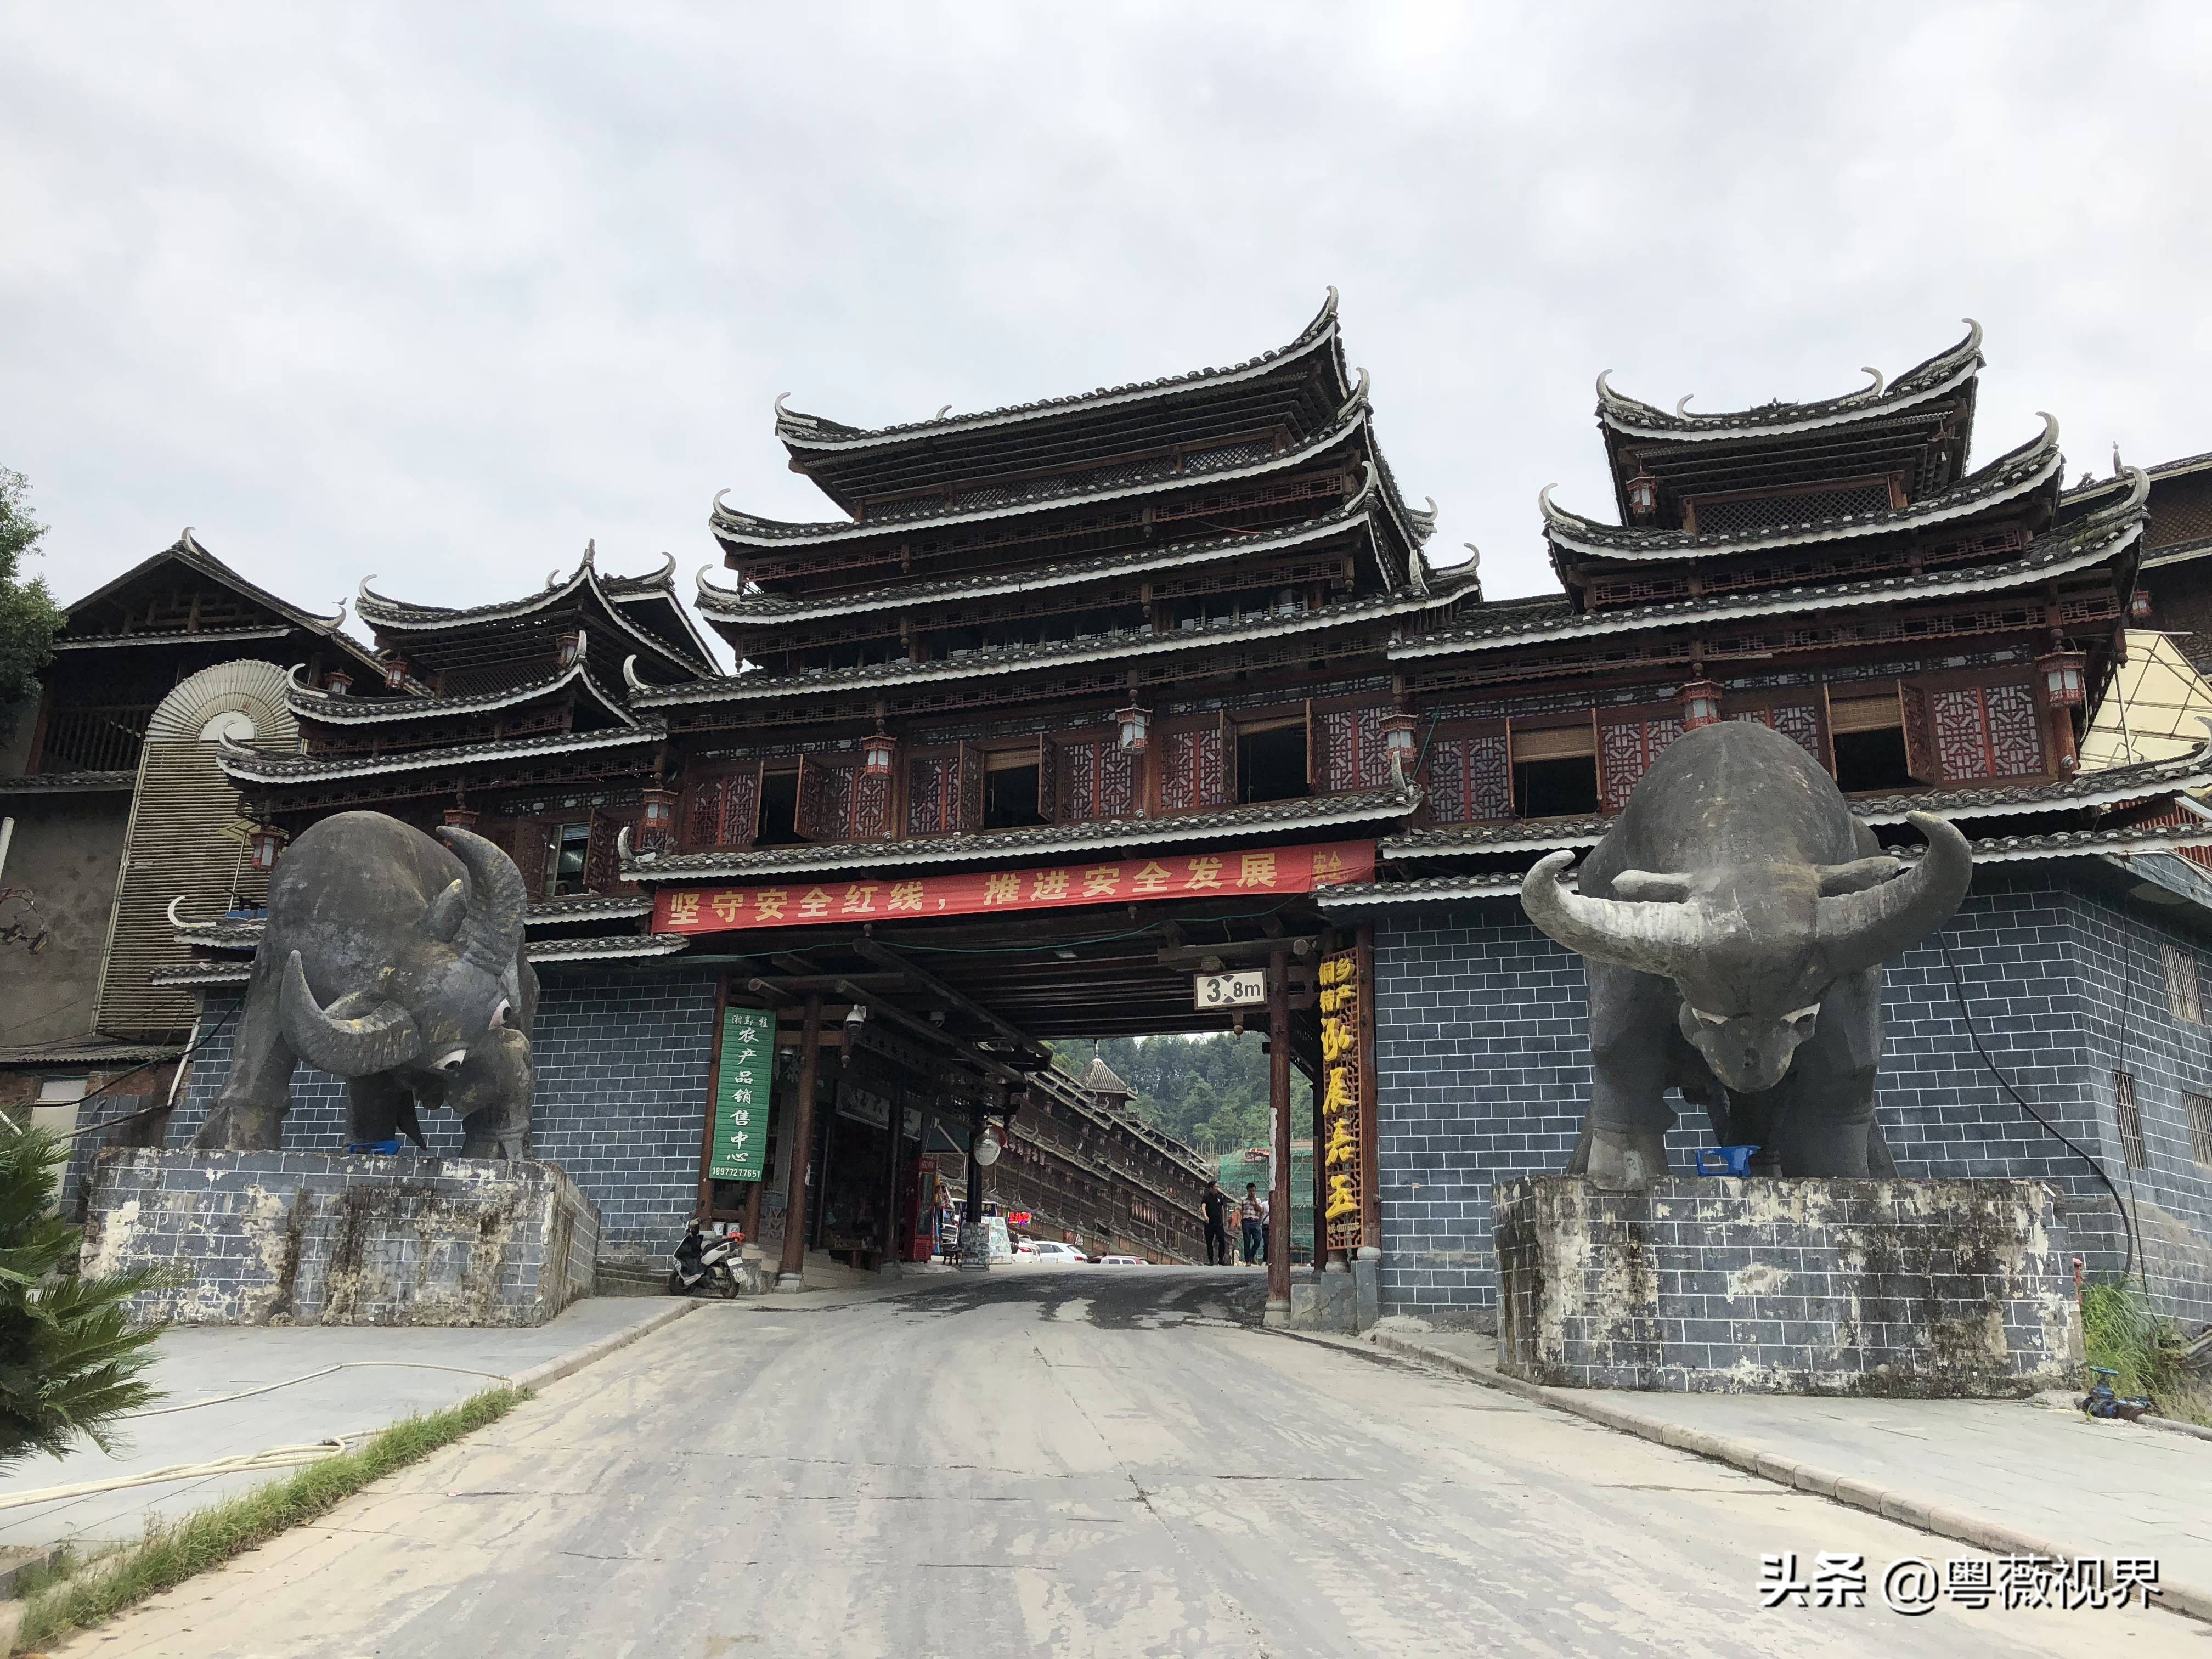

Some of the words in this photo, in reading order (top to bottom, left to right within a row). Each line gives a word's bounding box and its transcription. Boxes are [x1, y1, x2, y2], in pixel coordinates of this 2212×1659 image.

[1207, 978, 1260, 1003] 3.8m
[727, 1027, 759, 1162] 农产品销售中心
[712, 1167, 761, 1178] 18977277651
